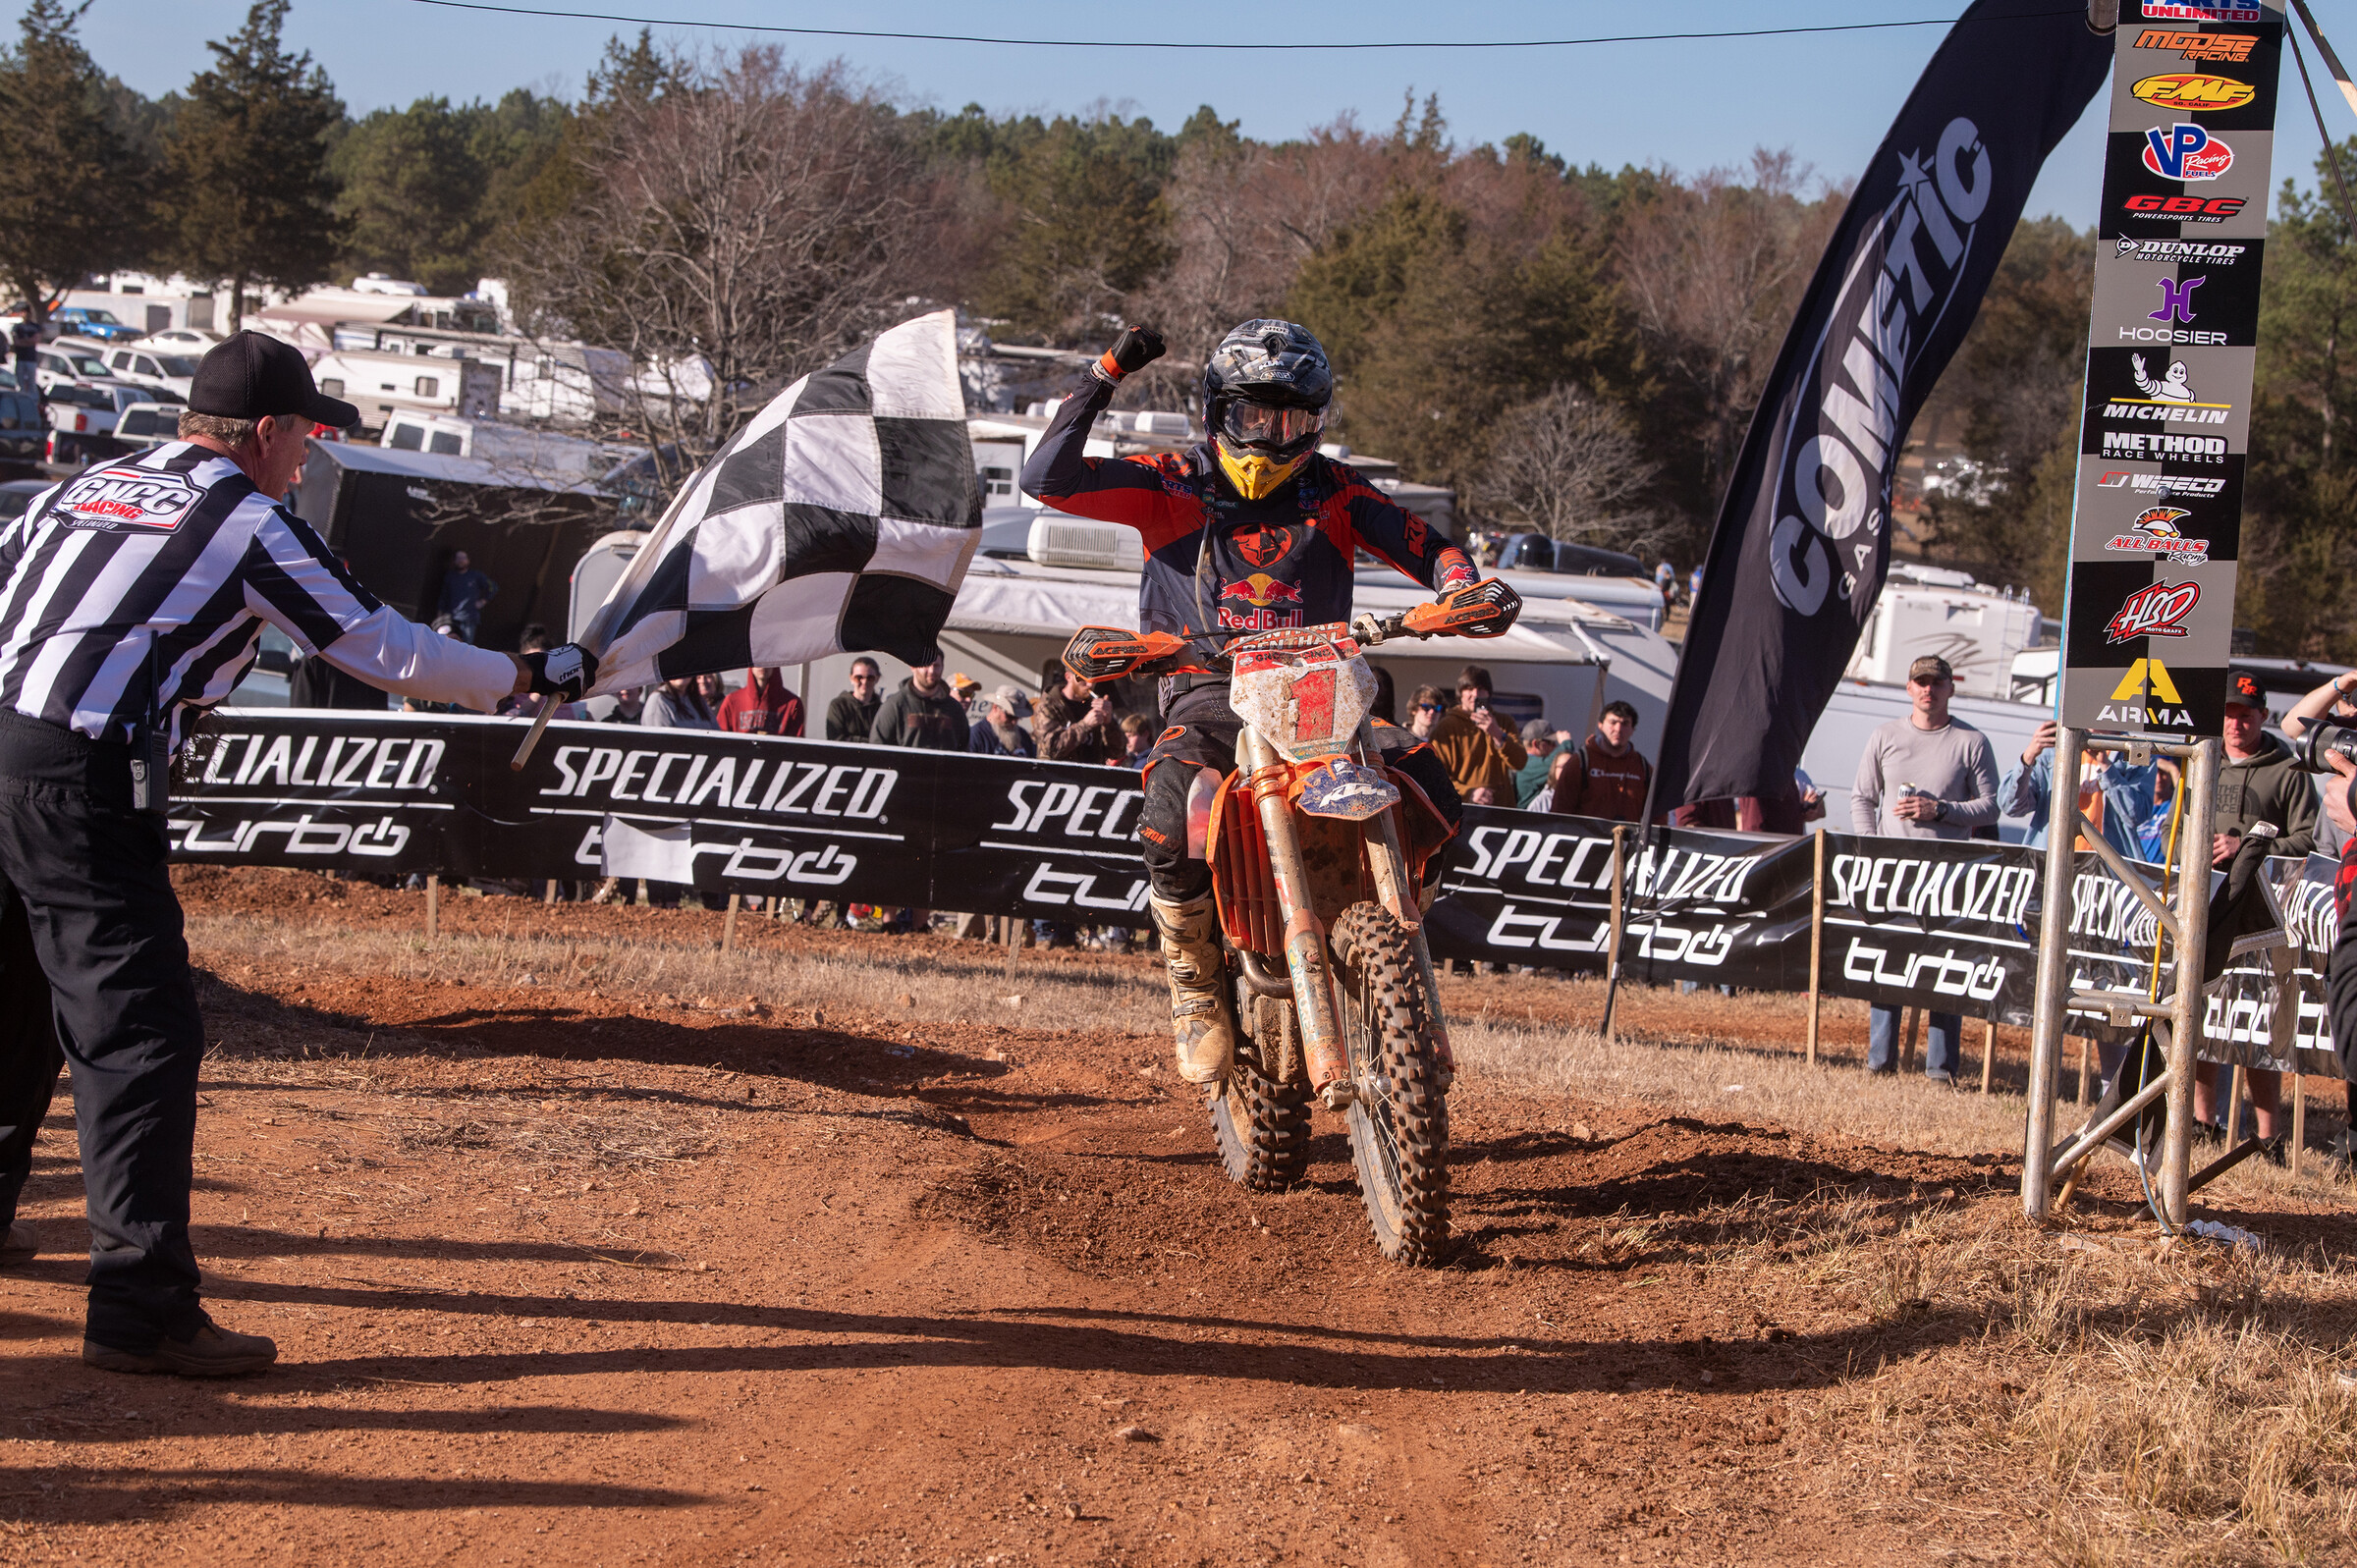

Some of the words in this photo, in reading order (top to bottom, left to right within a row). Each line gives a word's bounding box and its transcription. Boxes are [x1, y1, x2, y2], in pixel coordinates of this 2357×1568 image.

[2142, 5, 2259, 22] UNLIMITED
[2133, 29, 2261, 52] MOOSE
[2180, 50, 2249, 63] RACING
[2133, 79, 2255, 102] FMF
[2146, 124, 2208, 178] VP
[2185, 153, 2235, 171] Racing
[2123, 194, 2245, 215] GBC
[2132, 212, 2194, 222] POWERSPORTS
[2135, 252, 2204, 264] MOTORCYCLE
[2206, 257, 2235, 266] TIRES
[2139, 241, 2246, 257] DUNLOP
[2118, 326, 2228, 346] HOOSIER
[1770, 117, 1992, 617] COMETIC
[2103, 404, 2229, 424] MICHELIN
[2103, 431, 2225, 456] METHOD
[2102, 449, 2145, 460] RACE
[2154, 452, 2224, 464] WHEELS
[62, 477, 193, 515] GNCC
[73, 500, 145, 520] RACING
[2107, 536, 2145, 550] ALL
[2146, 538, 2209, 553] BALLS
[2167, 551, 2208, 566] Racing
[559, 666, 581, 682] thor
[1289, 668, 1338, 743] 1
[2096, 705, 2195, 727] ARMA
[539, 745, 899, 820] SPECIALIZED
[575, 825, 857, 886] trbo
[1825, 853, 2036, 925] SPECIALIZED
[1843, 936, 2006, 1001] turbo
